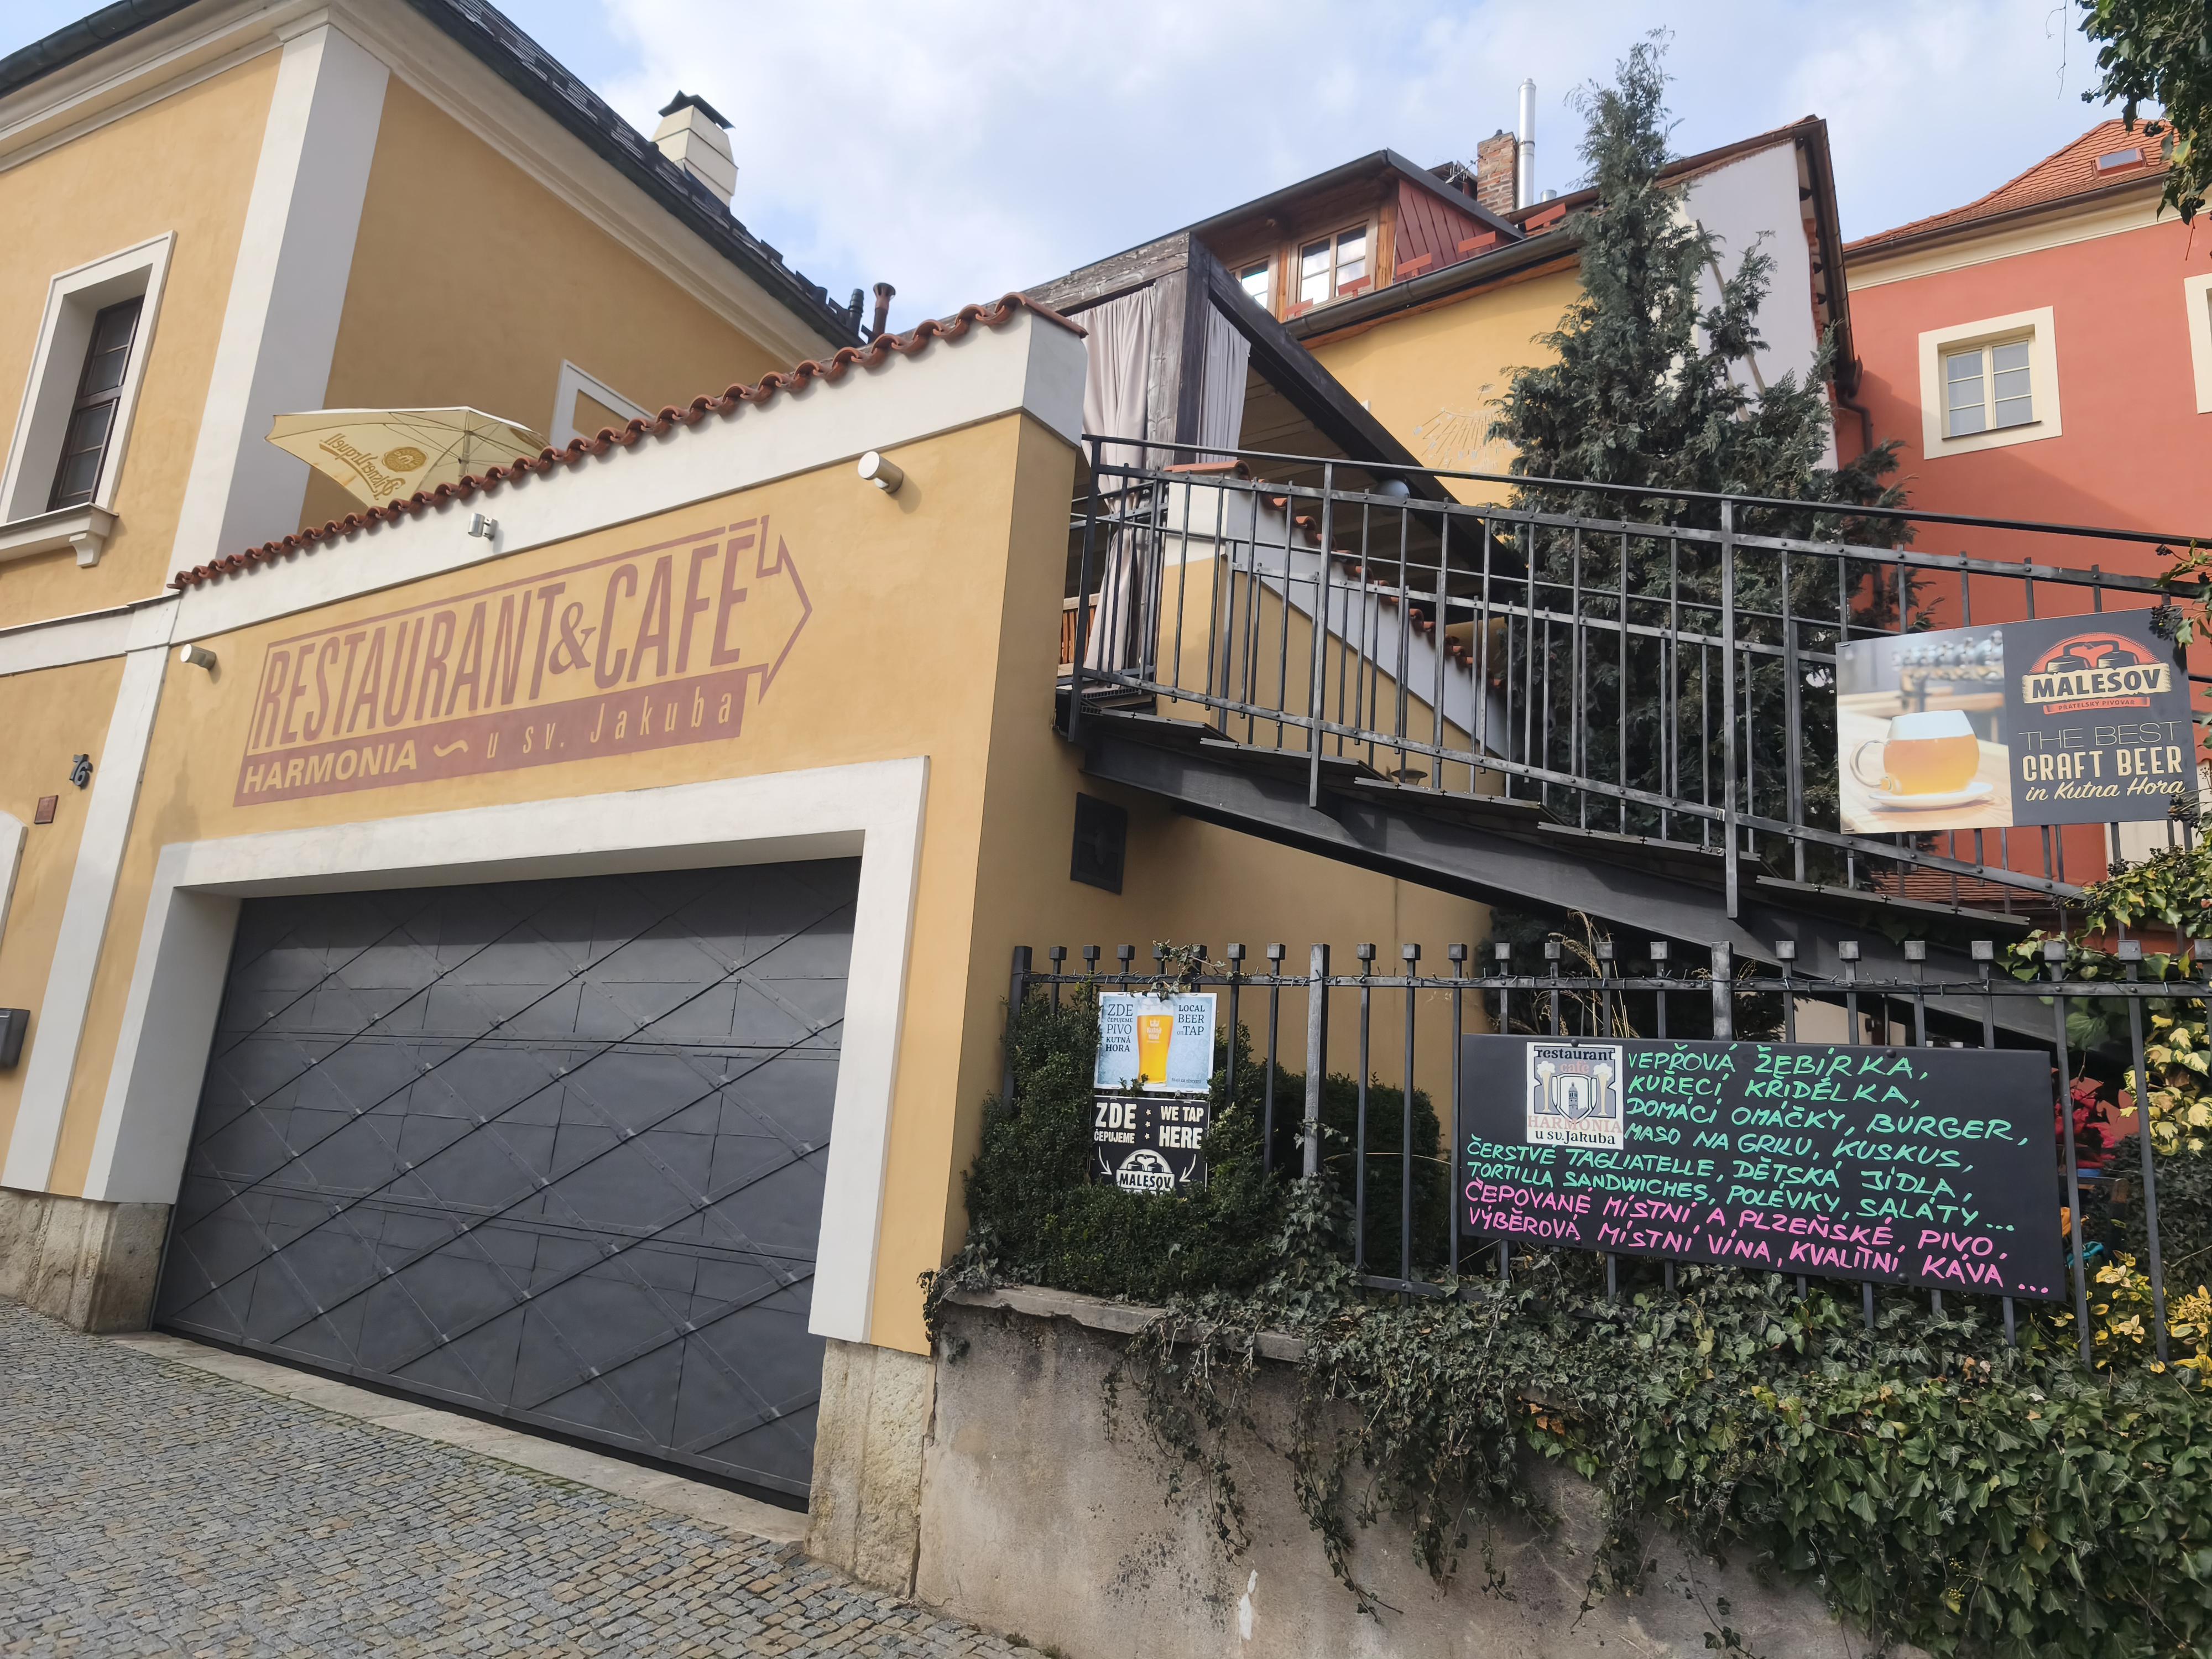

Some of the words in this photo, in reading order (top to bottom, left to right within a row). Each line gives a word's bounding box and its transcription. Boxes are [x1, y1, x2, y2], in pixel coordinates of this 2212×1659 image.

[242, 740, 417, 794] HARMONIA
[487, 732, 499, 759] u
[523, 722, 565, 754] sv.
[590, 686, 732, 743] Jakuba
[2018, 728, 2084, 750] THE
[2095, 721, 2182, 747] BEST
[2022, 750, 2103, 781] CRAFT
[2116, 745, 2183, 776] BEER
[2025, 786, 2049, 801] in
[2054, 781, 2120, 800] Kutna
[2127, 776, 2185, 797] Hora
[1107, 1004, 1133, 1016] ZDE
[1178, 1014, 1204, 1024] BEER
[1106, 1035, 1131, 1044] KUTNÁ
[1107, 1024, 1132, 1035] PIVO
[1537, 1048, 1615, 1061] restaurant
[1627, 1042, 1736, 1073] VEPŘOVÁ
[1627, 1071, 1730, 1097] KUŘECÍ
[1095, 1102, 1138, 1130] ZDE
[1160, 1105, 1180, 1121] WE
[1182, 1107, 1204, 1123] TAP
[1527, 1115, 1623, 1134] HARMONIA
[1626, 1095, 1722, 1124] DOMÁCÍ
[1731, 1100, 1855, 1136] OMÁČKY,
[1866, 1113, 2028, 1146] BURGER,
[1094, 1129, 1135, 1144] ČEPUJEME
[1159, 1125, 1203, 1150] HERE
[1535, 1130, 1544, 1140] u
[1624, 1121, 1682, 1146] MASO
[1692, 1130, 1729, 1150] NA
[1832, 1139, 1974, 1173] KUSKUS,
[1467, 1133, 1557, 1165] ČERSTVÉ
[1566, 1148, 1724, 1182] TAGLIATELLE,
[1733, 1156, 1843, 1188] DĚTSKÁ
[1861, 1166, 1973, 1202] JÍDLA,
[1467, 1161, 1553, 1188] TORTILLA
[1563, 1171, 1717, 1206] SANDWICHES,
[1726, 1182, 1850, 1220] POLÉVKY,
[1464, 1177, 1593, 1215] ČEPOVANÉ
[1603, 1194, 1698, 1223] MÍSTNÍ
[1706, 1207, 1725, 1227] A
[1739, 1209, 1894, 1246] PLZEŇSKÉ
[1918, 1229, 2008, 1259] PIVO,
[1469, 1205, 1581, 1240] VÝBĚROVÁ
[1597, 1220, 1700, 1253] MÍSTNÍ
[1708, 1229, 1782, 1268] VÍNA,
